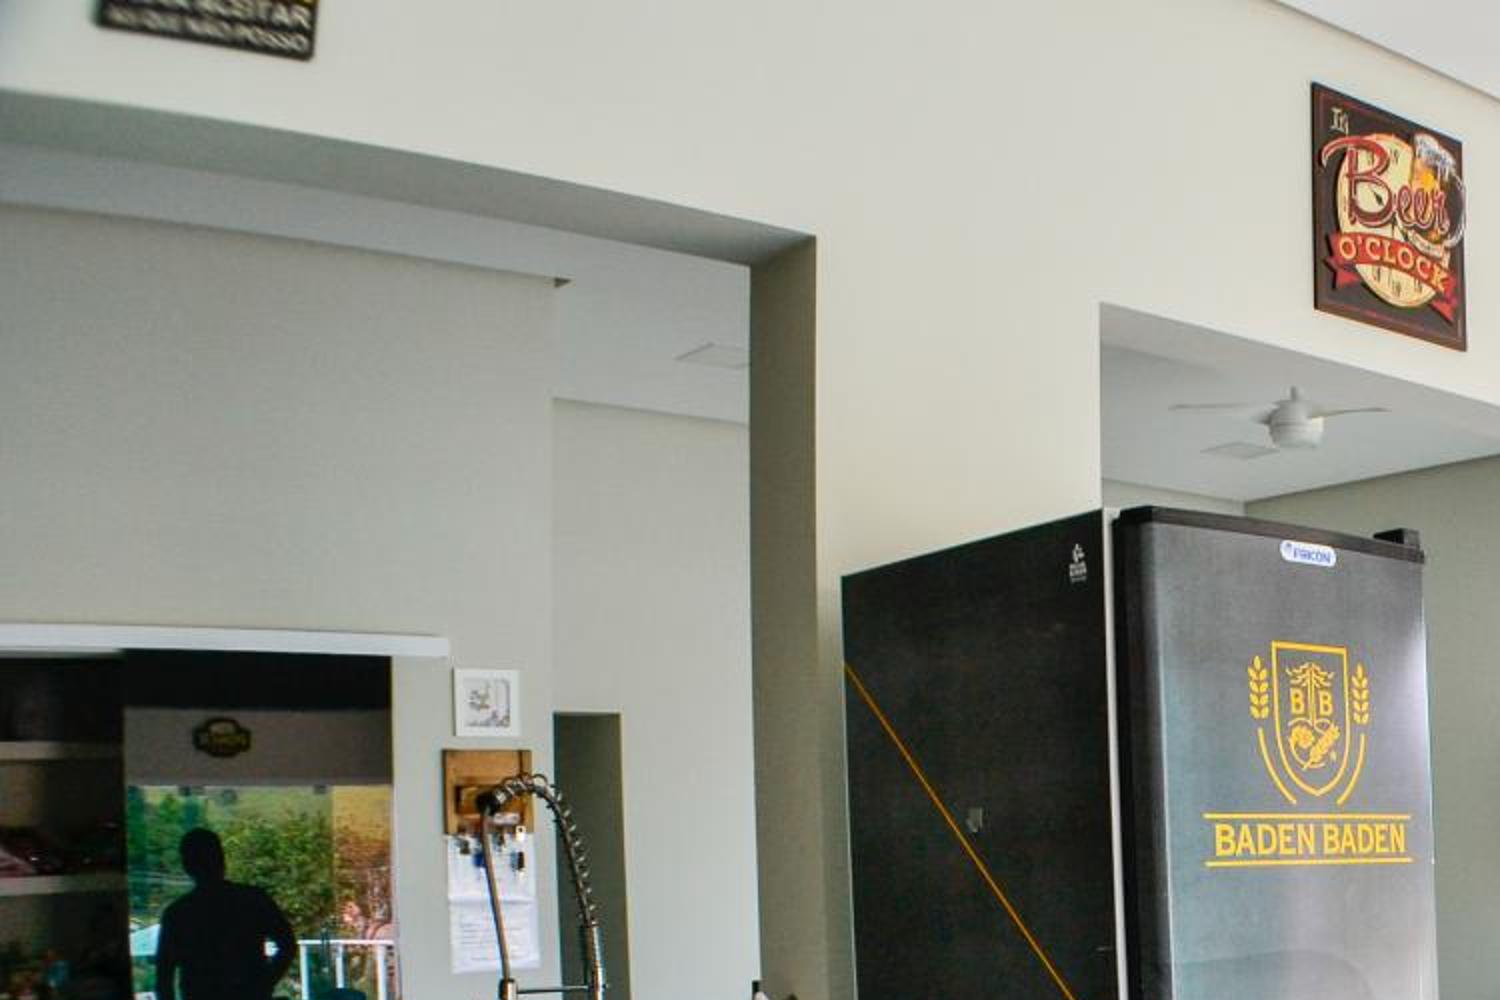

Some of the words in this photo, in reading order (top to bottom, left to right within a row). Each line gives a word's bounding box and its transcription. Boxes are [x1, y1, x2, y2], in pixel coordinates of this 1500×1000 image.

[1320, 132, 1451, 234] Beer
[1337, 235, 1450, 293] O'CLOCK
[1214, 822, 1316, 857] BADEN
[1322, 823, 1406, 855] BADEN
